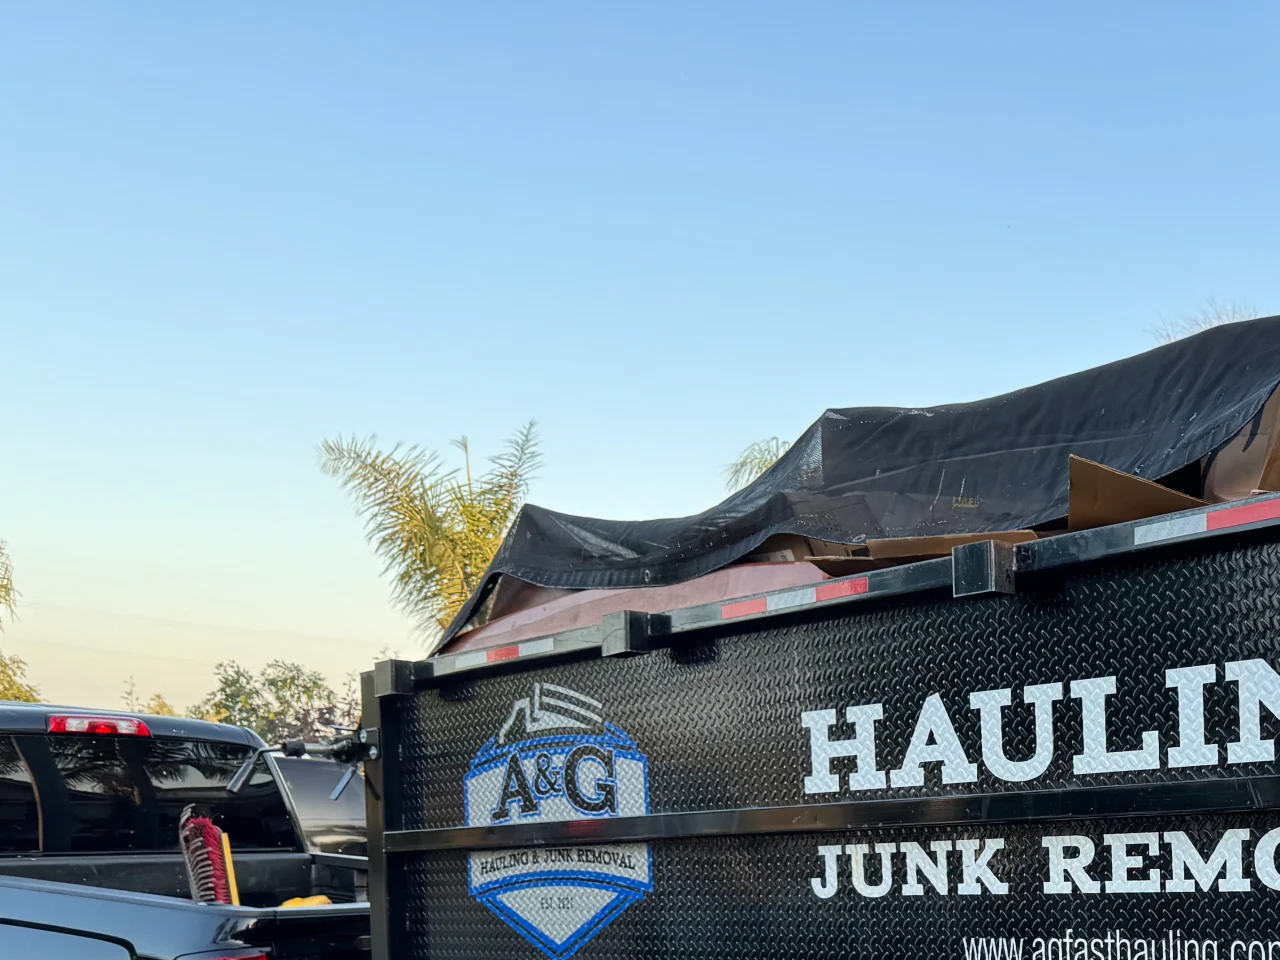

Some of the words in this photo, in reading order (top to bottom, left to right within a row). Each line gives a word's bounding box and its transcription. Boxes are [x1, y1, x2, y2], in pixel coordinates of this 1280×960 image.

[492, 743, 618, 823] A&G
[480, 852, 529, 875] HAULING
[533, 850, 539, 864] &
[544, 848, 573, 863] JUNK
[577, 849, 636, 870] REMOVAL
[811, 838, 1009, 898] JUNK
